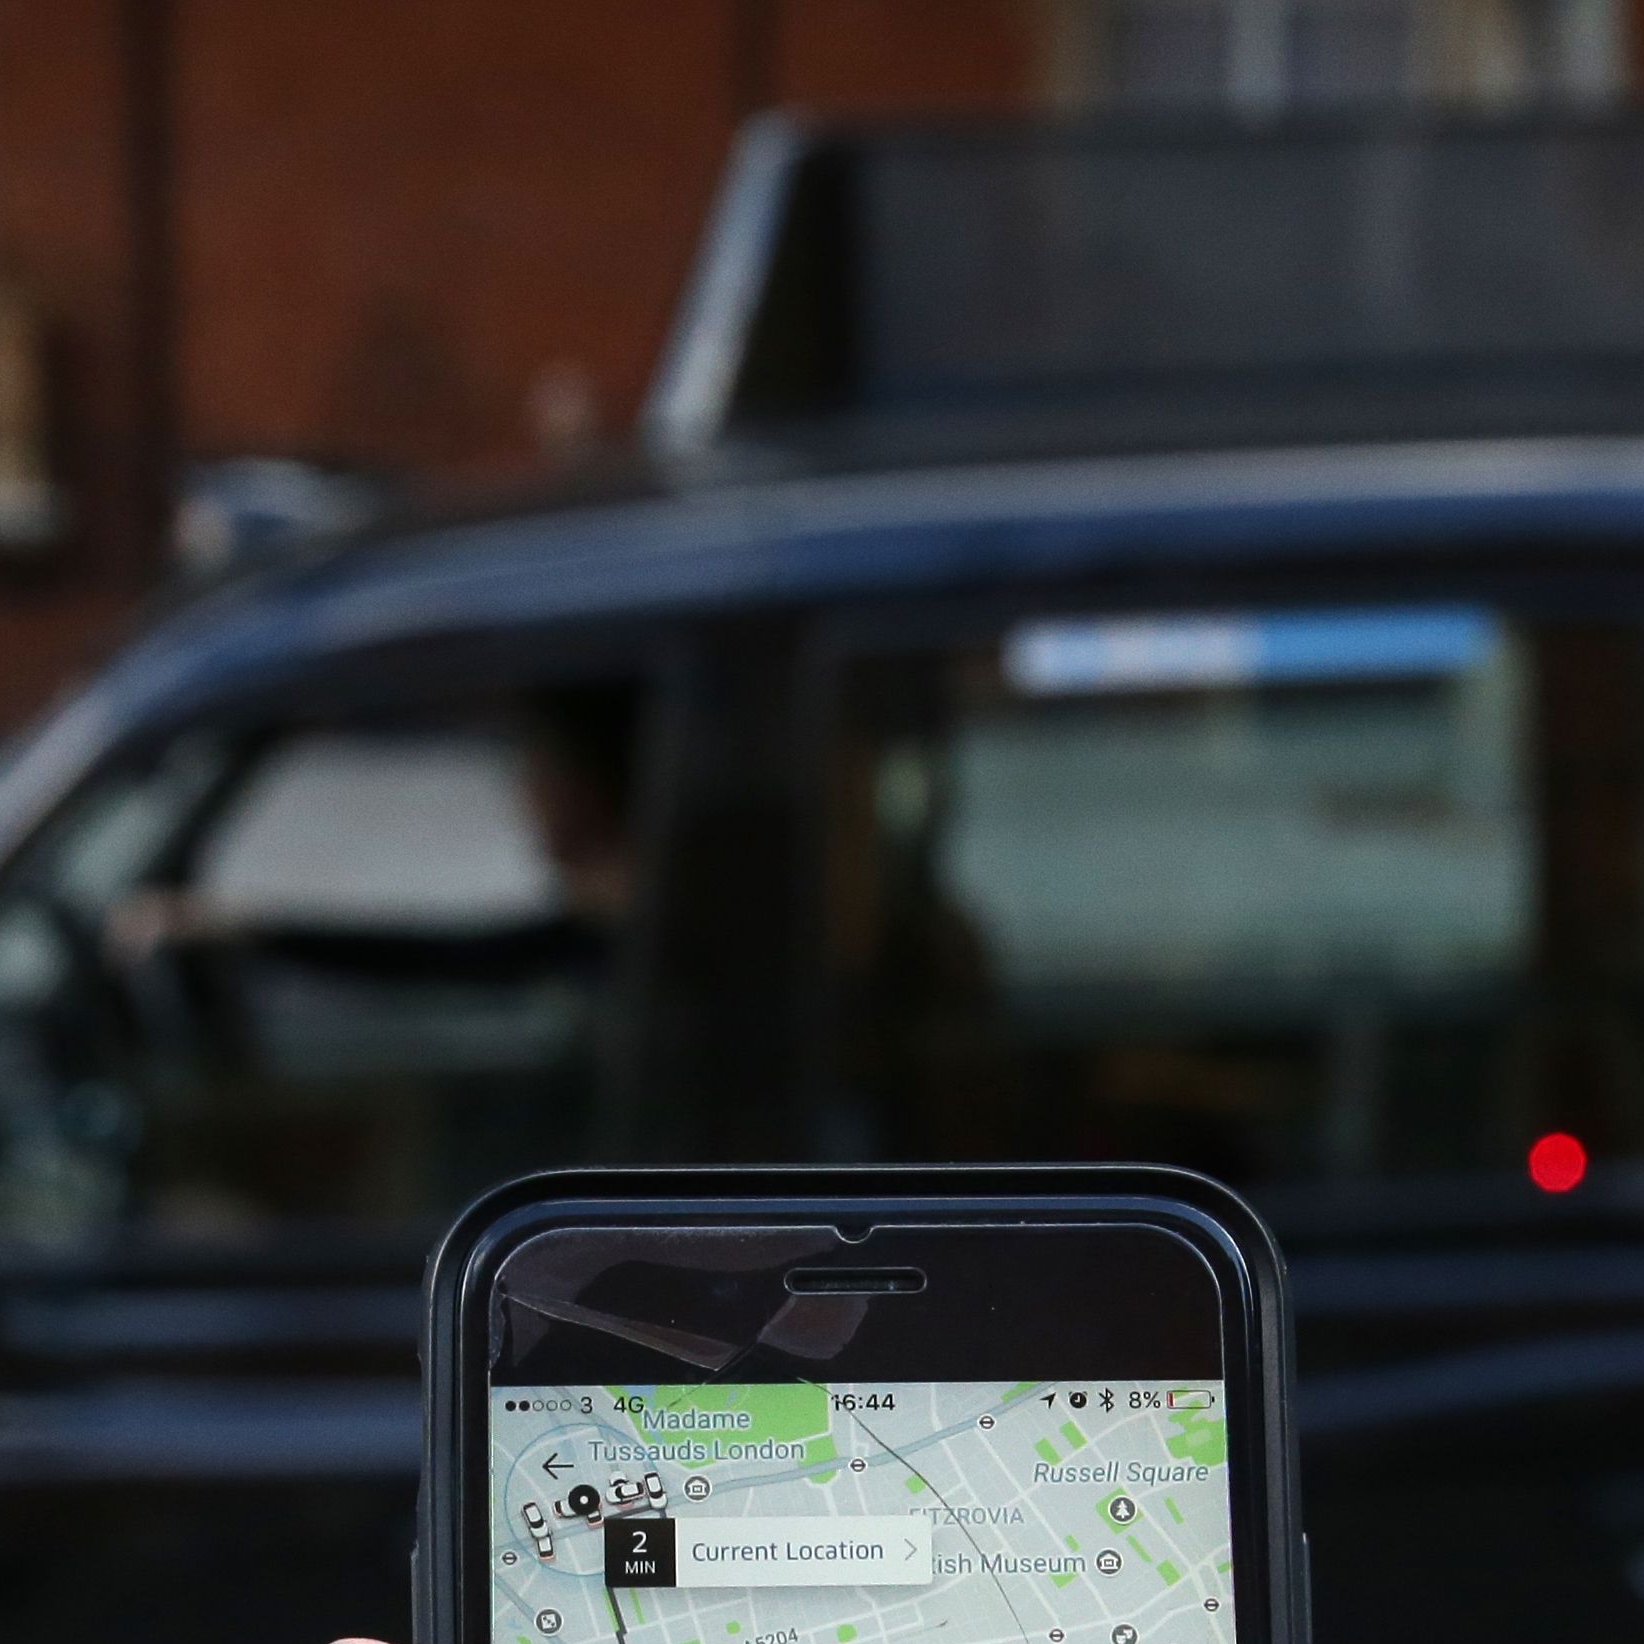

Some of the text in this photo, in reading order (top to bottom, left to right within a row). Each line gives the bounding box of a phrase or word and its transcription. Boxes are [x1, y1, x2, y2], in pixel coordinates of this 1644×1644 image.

[580, 1395, 644, 1414] 3 4G
[831, 1393, 896, 1412] 16:44
[1128, 1391, 1161, 1410] 8%
[642, 1408, 750, 1430] Madame
[589, 1440, 804, 1462] Tussauds London
[1033, 1461, 1209, 1487] Russell Square
[632, 1531, 648, 1554] 2
[692, 1540, 884, 1562] Current Location
[624, 1560, 656, 1575] MIN
[980, 1552, 1087, 1574] Museum
